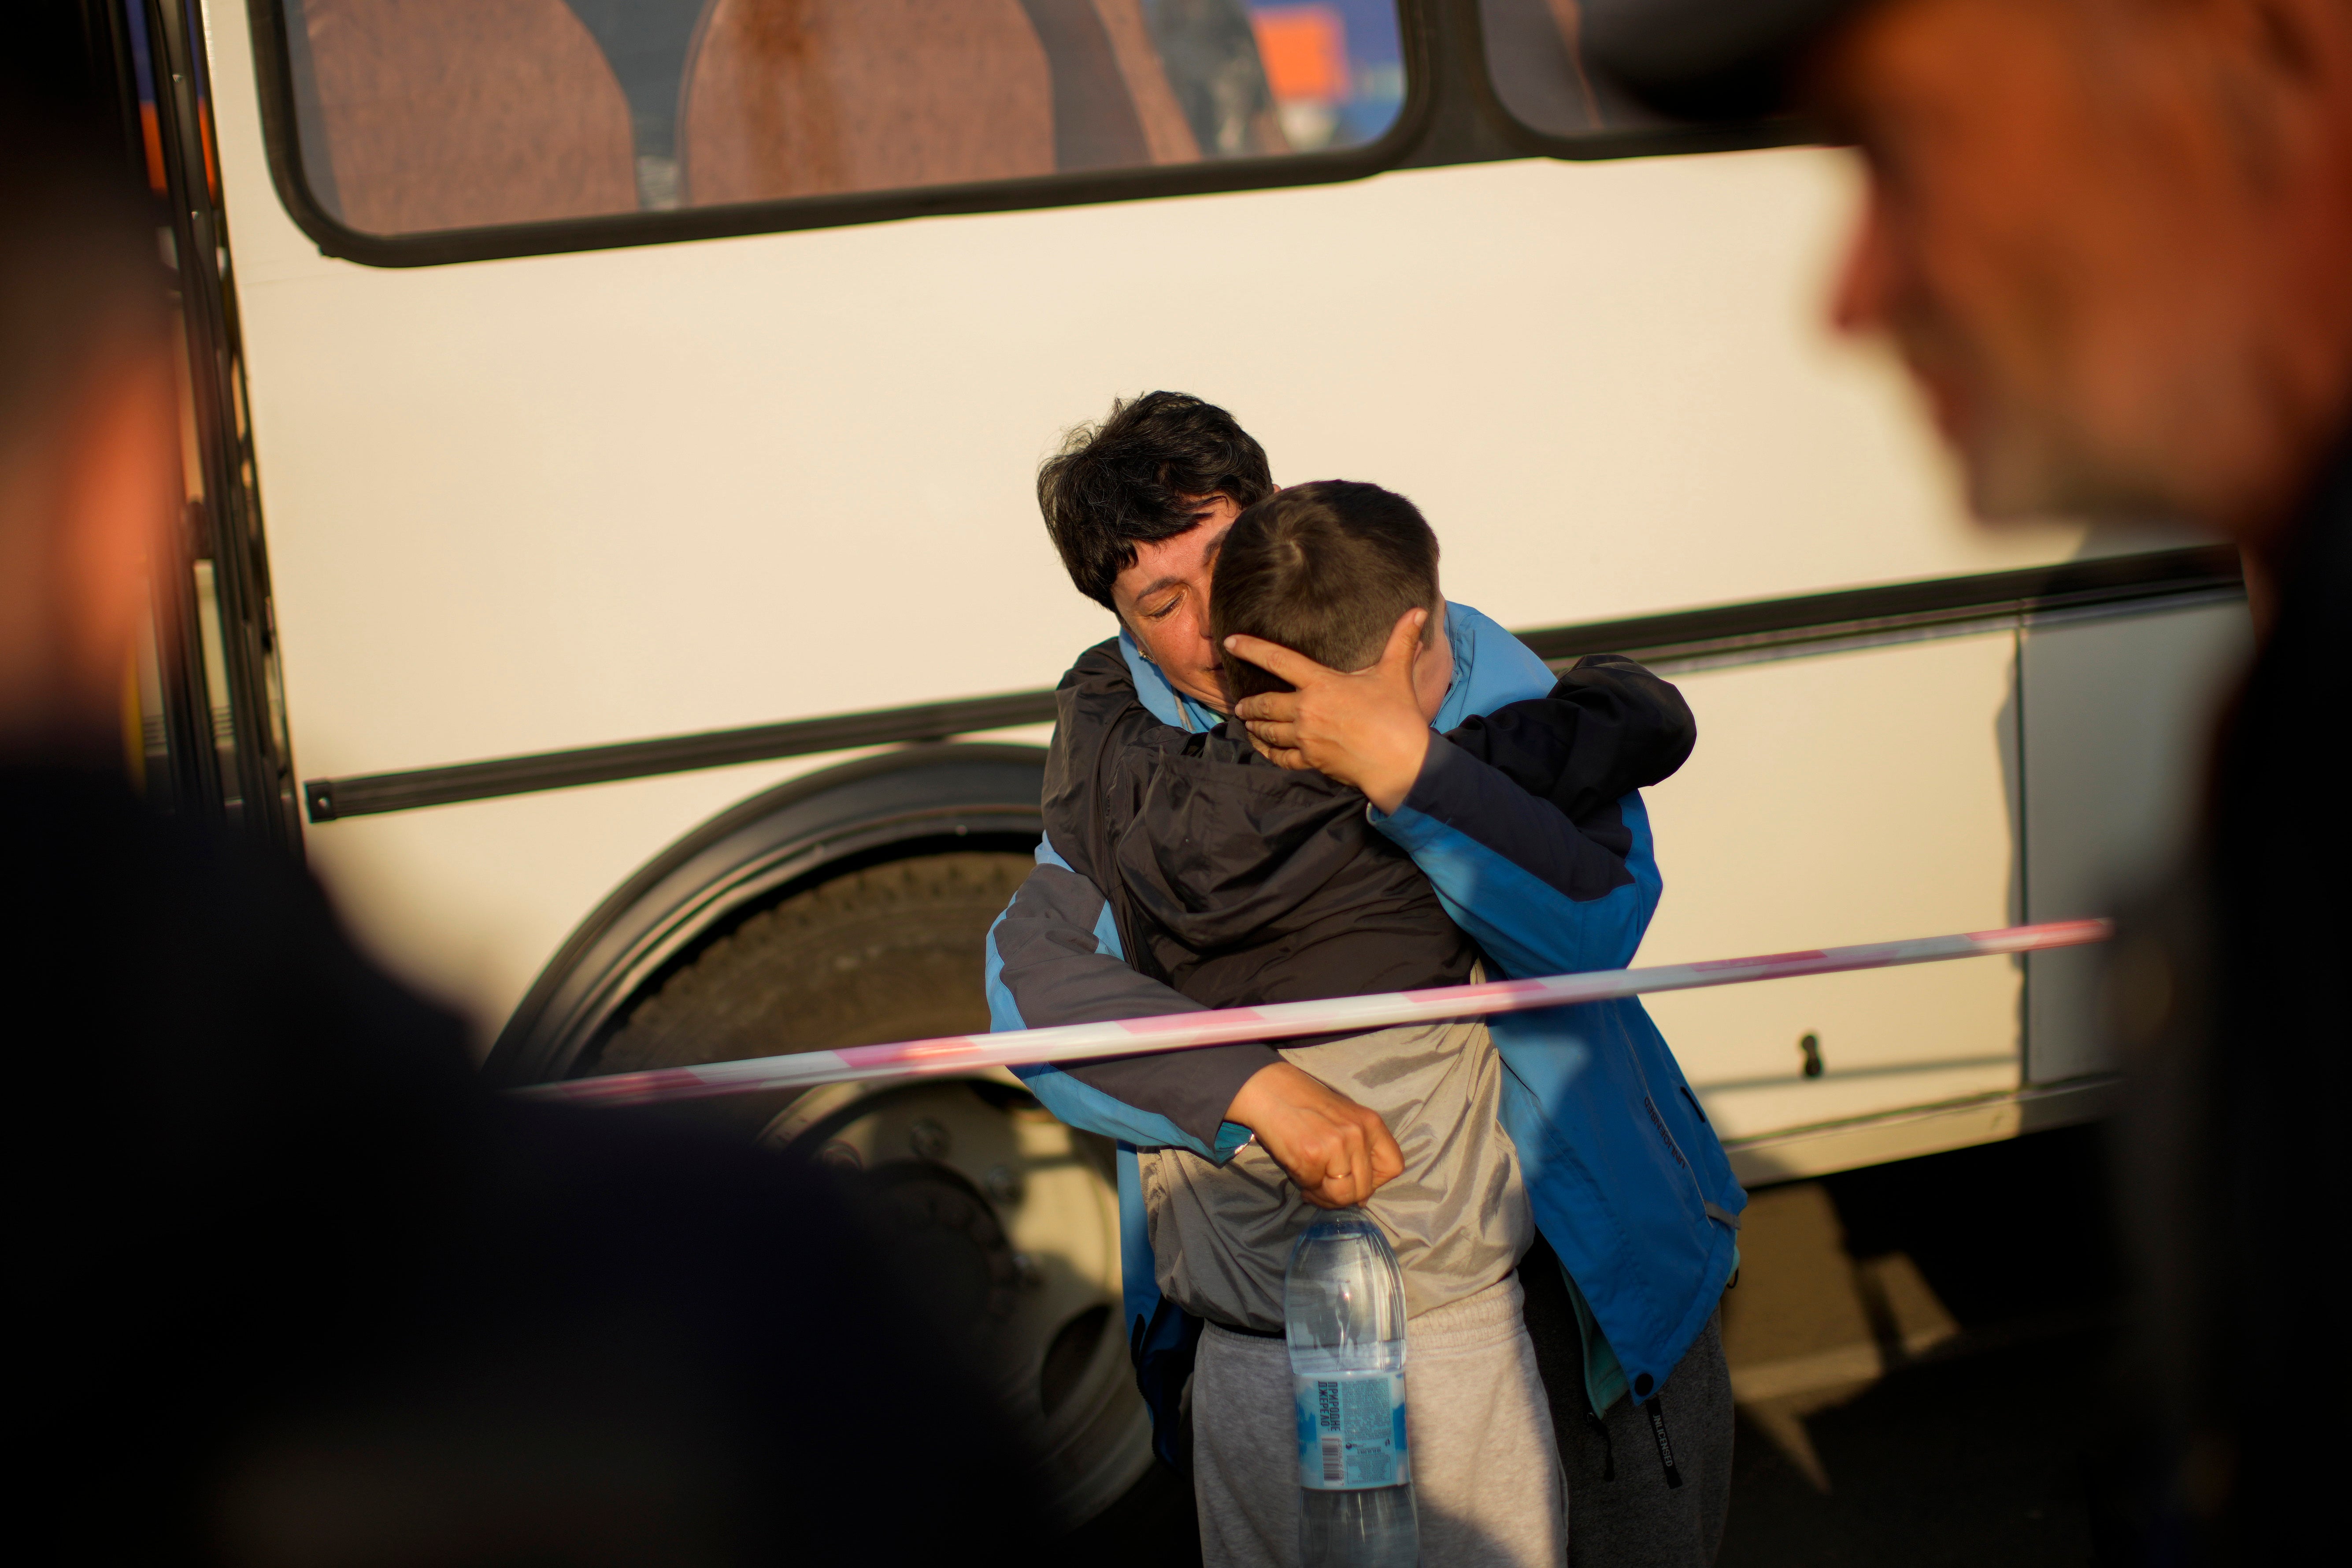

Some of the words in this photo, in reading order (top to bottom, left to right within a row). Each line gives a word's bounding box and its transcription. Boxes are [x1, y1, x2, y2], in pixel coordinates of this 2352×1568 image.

[1645, 1096, 1685, 1169] UNLICENSED
[1319, 1381, 1330, 1426] ДЖЕРЕЛО
[1328, 1382, 1341, 1431] ПРИРОДНЕ
